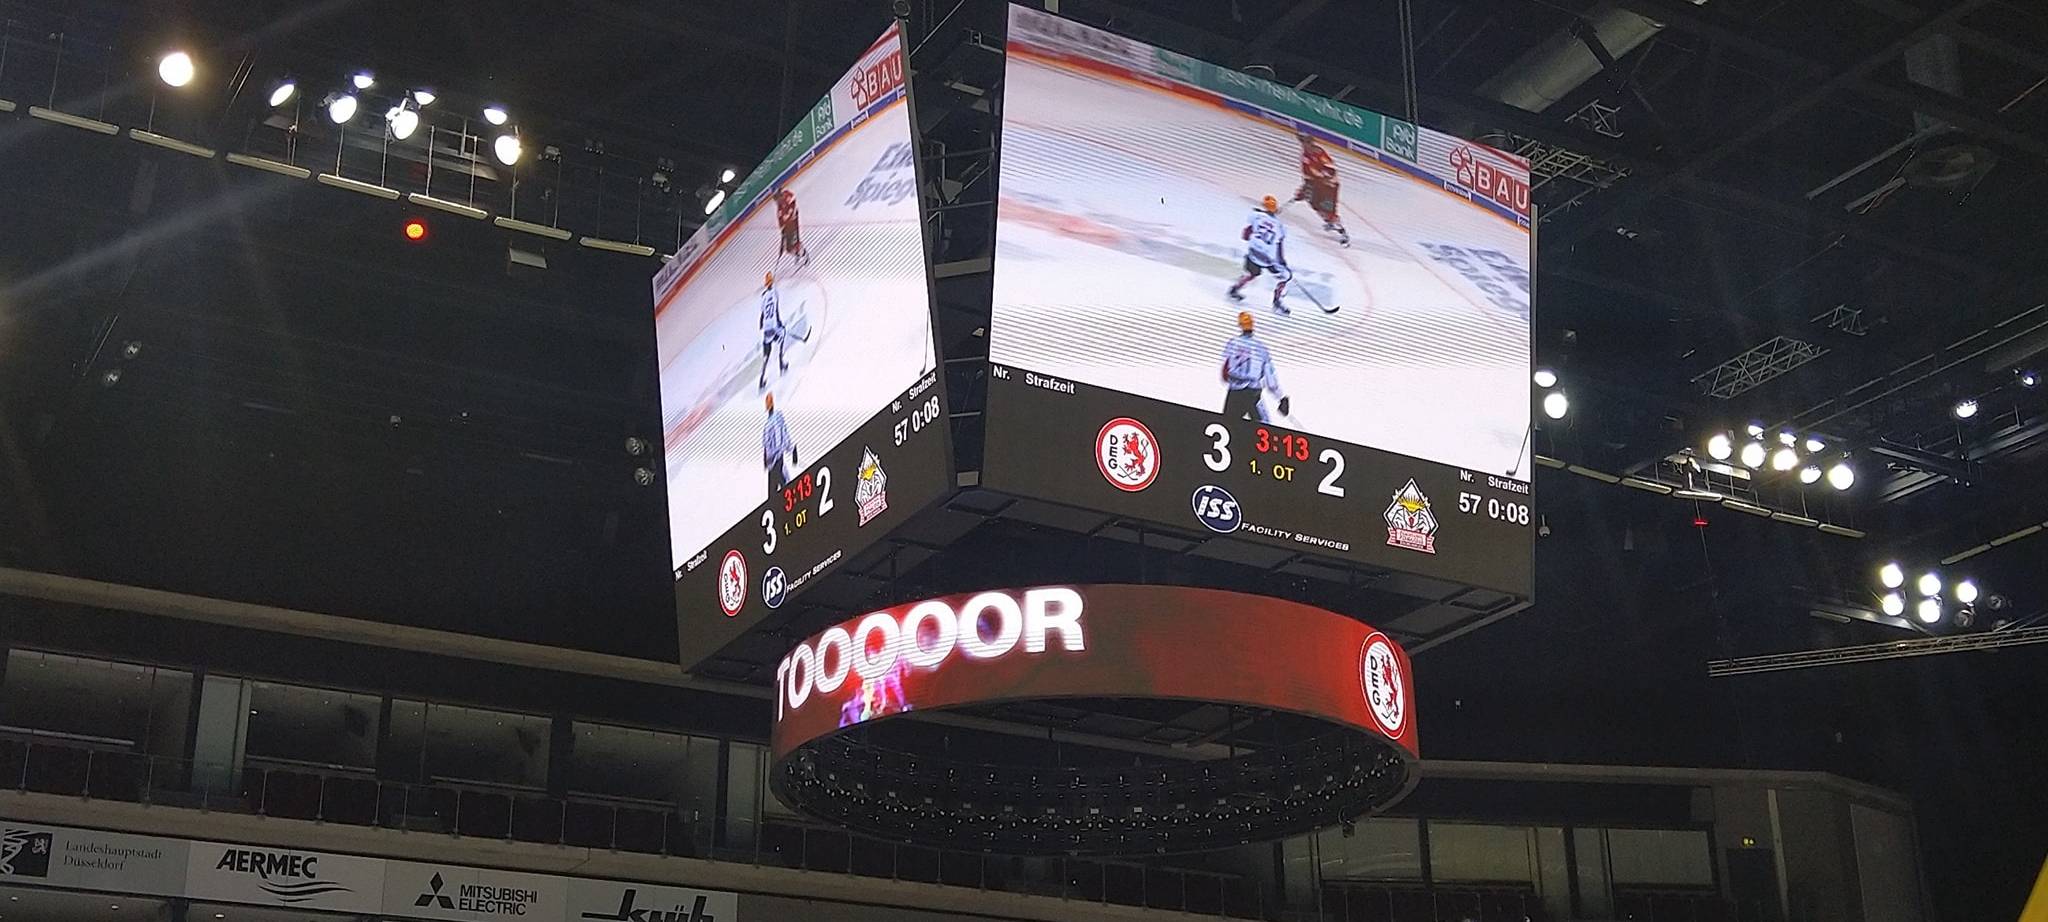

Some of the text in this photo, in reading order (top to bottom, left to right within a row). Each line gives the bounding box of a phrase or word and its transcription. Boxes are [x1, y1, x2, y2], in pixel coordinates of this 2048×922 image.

[892, 371, 937, 414] Nr. Strafzeit
[993, 365, 1075, 394] Nr. Strafzeit
[894, 395, 940, 446] 57 0:08
[1202, 423, 1232, 472] 3
[1256, 428, 1309, 461] 3:13
[1250, 460, 1294, 481] 1. OT
[1318, 449, 1345, 497] 2
[1460, 470, 1529, 495] Nr. Strafzeit
[784, 473, 812, 512] 3:13
[816, 466, 834, 517] 2
[784, 509, 807, 535] 1. OT
[1458, 491, 1529, 525] 57 0:08
[761, 509, 777, 554] 3
[1241, 522, 1349, 551] FACILITY SERVICES
[786, 570, 812, 594] FACILITY
[777, 587, 1087, 723] TOOOOOR
[65, 840, 162, 860] Landeshauptstadt
[216, 848, 318, 879] AERMEC
[459, 898, 527, 916] ELECTRIC
[460, 884, 538, 904] MITSUBISHI
